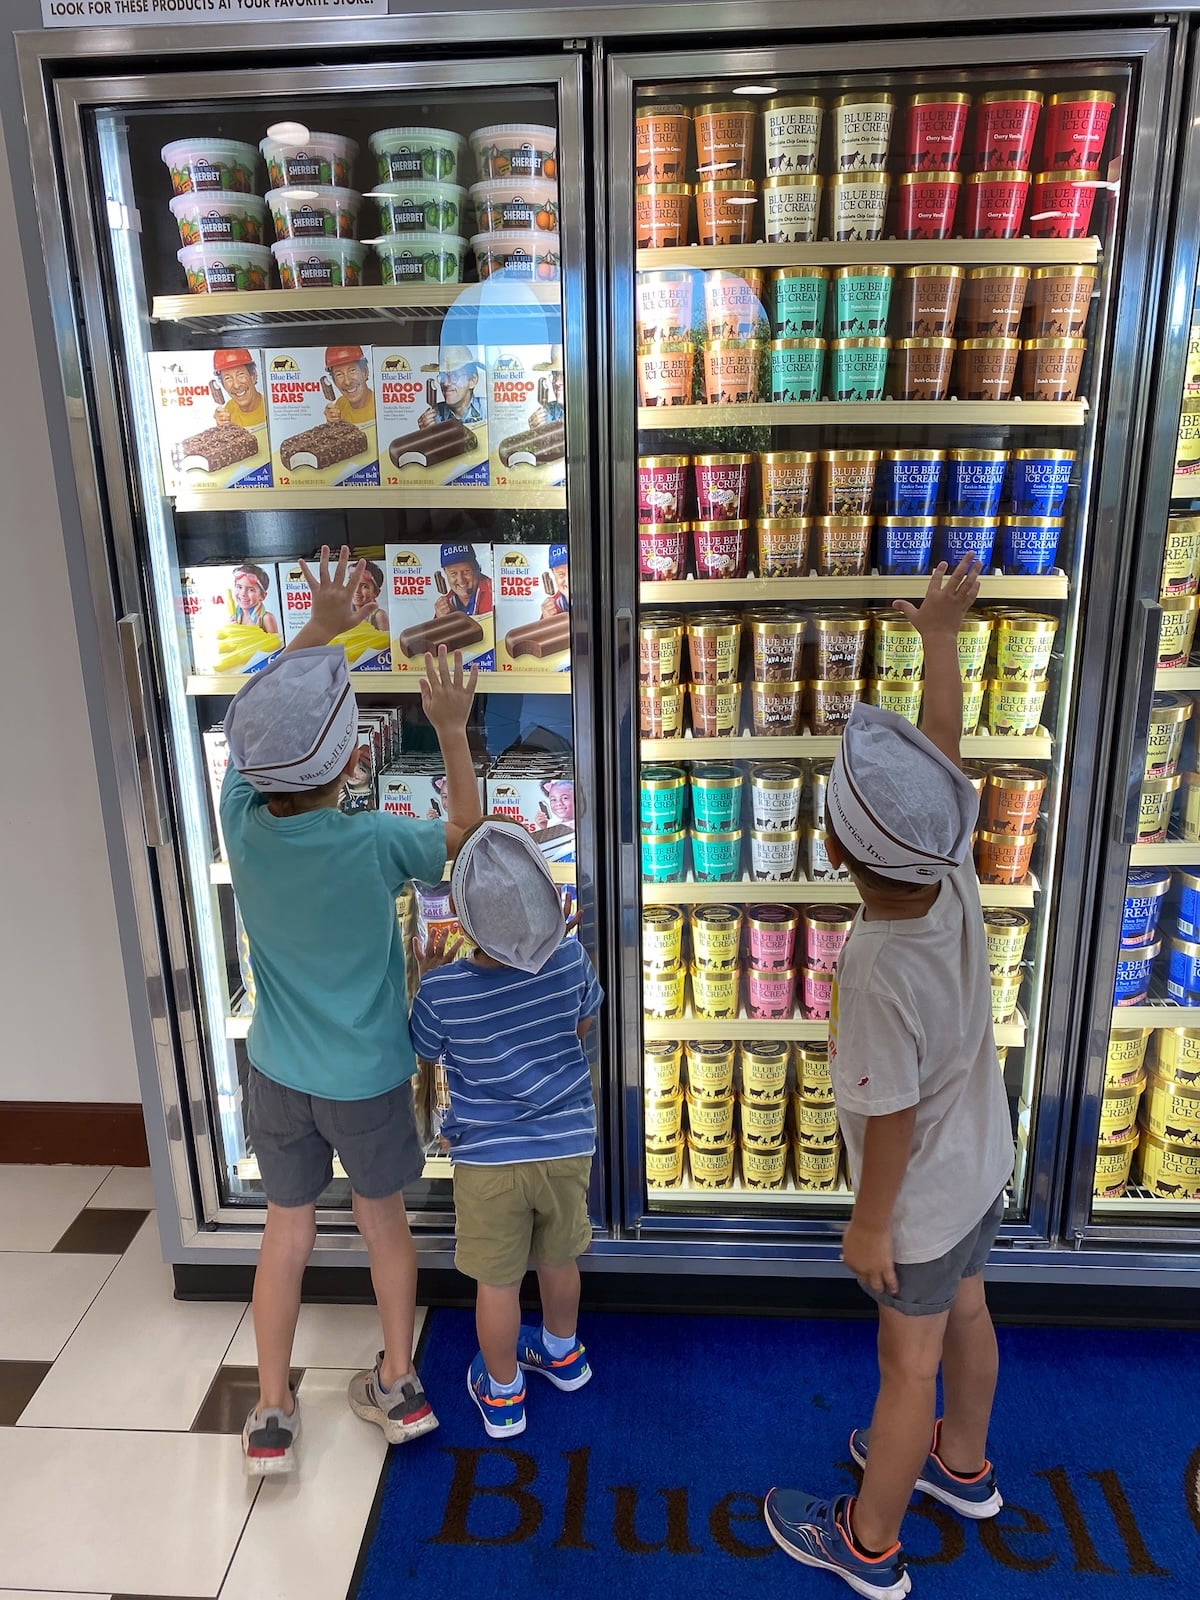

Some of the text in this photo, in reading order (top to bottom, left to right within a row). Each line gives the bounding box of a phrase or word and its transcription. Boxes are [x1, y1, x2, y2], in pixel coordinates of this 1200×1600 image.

[50, 2, 85, 16] LOOK
[88, 1, 112, 14] FOR
[115, 0, 149, 13] THESE
[152, 0, 214, 12] PRODUCTS
[218, 0, 232, 9] AT
[237, 0, 270, 9] YOUR
[770, 115, 797, 127] BLUE
[843, 112, 872, 123] BLUE
[770, 126, 784, 137] ICE
[844, 123, 860, 134] ICE
[391, 160, 421, 171] SHERBET
[511, 156, 542, 168] SHERBET
[289, 165, 320, 175] SHERBET
[840, 190, 868, 201] BLUE
[840, 200, 856, 210] ICE
[394, 212, 423, 223] SHERBET
[503, 210, 534, 221] SHERBET
[293, 217, 324, 227] SHERBET
[395, 263, 422, 274] SHERBET
[504, 261, 534, 272] SHERBET
[301, 268, 331, 278] SHERBET
[840, 282, 865, 293] BLUE
[840, 292, 855, 302] ICE
[838, 353, 887, 363] BLUE BELL
[838, 363, 853, 372] ICE
[270, 372, 300, 381] Blue Bell
[381, 373, 397, 381] Blue
[509, 372, 523, 380] Bell
[271, 382, 320, 393] KRUNCH
[382, 382, 423, 393] MOOO
[493, 381, 535, 392] MOOO
[271, 393, 304, 403] BARS
[382, 392, 415, 403] BARS
[493, 391, 527, 403] BARS
[893, 466, 941, 475] BLUE BELL
[957, 466, 1005, 475] BLUE BELL
[1025, 465, 1050, 474] BLUE
[279, 477, 291, 485] 12
[387, 477, 398, 485] 12
[496, 477, 507, 485] 12
[893, 474, 939, 483] ICE CREAM
[956, 474, 1002, 484] ICE CREAM
[1024, 474, 1070, 483] ICE CREAM
[886, 531, 912, 540] BLUE
[948, 531, 973, 540] BLUE
[1011, 531, 1060, 540] BLUE BELL
[886, 540, 931, 549] ICE CREAM
[948, 540, 993, 549] ICE CREAM
[1011, 540, 1057, 549] ICE CREAM
[443, 545, 469, 556] COACH
[500, 567, 515, 575] Blue
[393, 576, 431, 586] FUDGE
[500, 576, 539, 586] FUDGE
[394, 586, 424, 595] BARS
[500, 586, 532, 596] BARS
[287, 592, 312, 601] BAN
[287, 601, 312, 610] POP
[1160, 614, 1191, 626] BELL
[1008, 635, 1032, 645] BLUE
[1008, 643, 1022, 653] ICE
[397, 663, 408, 671] 12
[502, 663, 513, 671] 12
[299, 770, 324, 782] Blue
[323, 751, 340, 770] Bell
[758, 792, 781, 800] BLUE
[1144, 793, 1170, 805] BELL
[384, 802, 411, 811] MINI
[492, 806, 520, 815] MINI
[866, 843, 888, 864] Inc.
[1132, 897, 1158, 908] BELL
[423, 907, 444, 916] CAKE
[987, 944, 1001, 952] ICE
[1126, 961, 1151, 972] BELL
[750, 1110, 769, 1118] BLUE
[801, 1110, 821, 1118] BLUE
[750, 1117, 761, 1125] ICE
[748, 1156, 769, 1164] BLUE
[1163, 1152, 1198, 1165] BLUE
[1162, 1160, 1183, 1171] ICE
[424, 1446, 779, 1558] Blue
